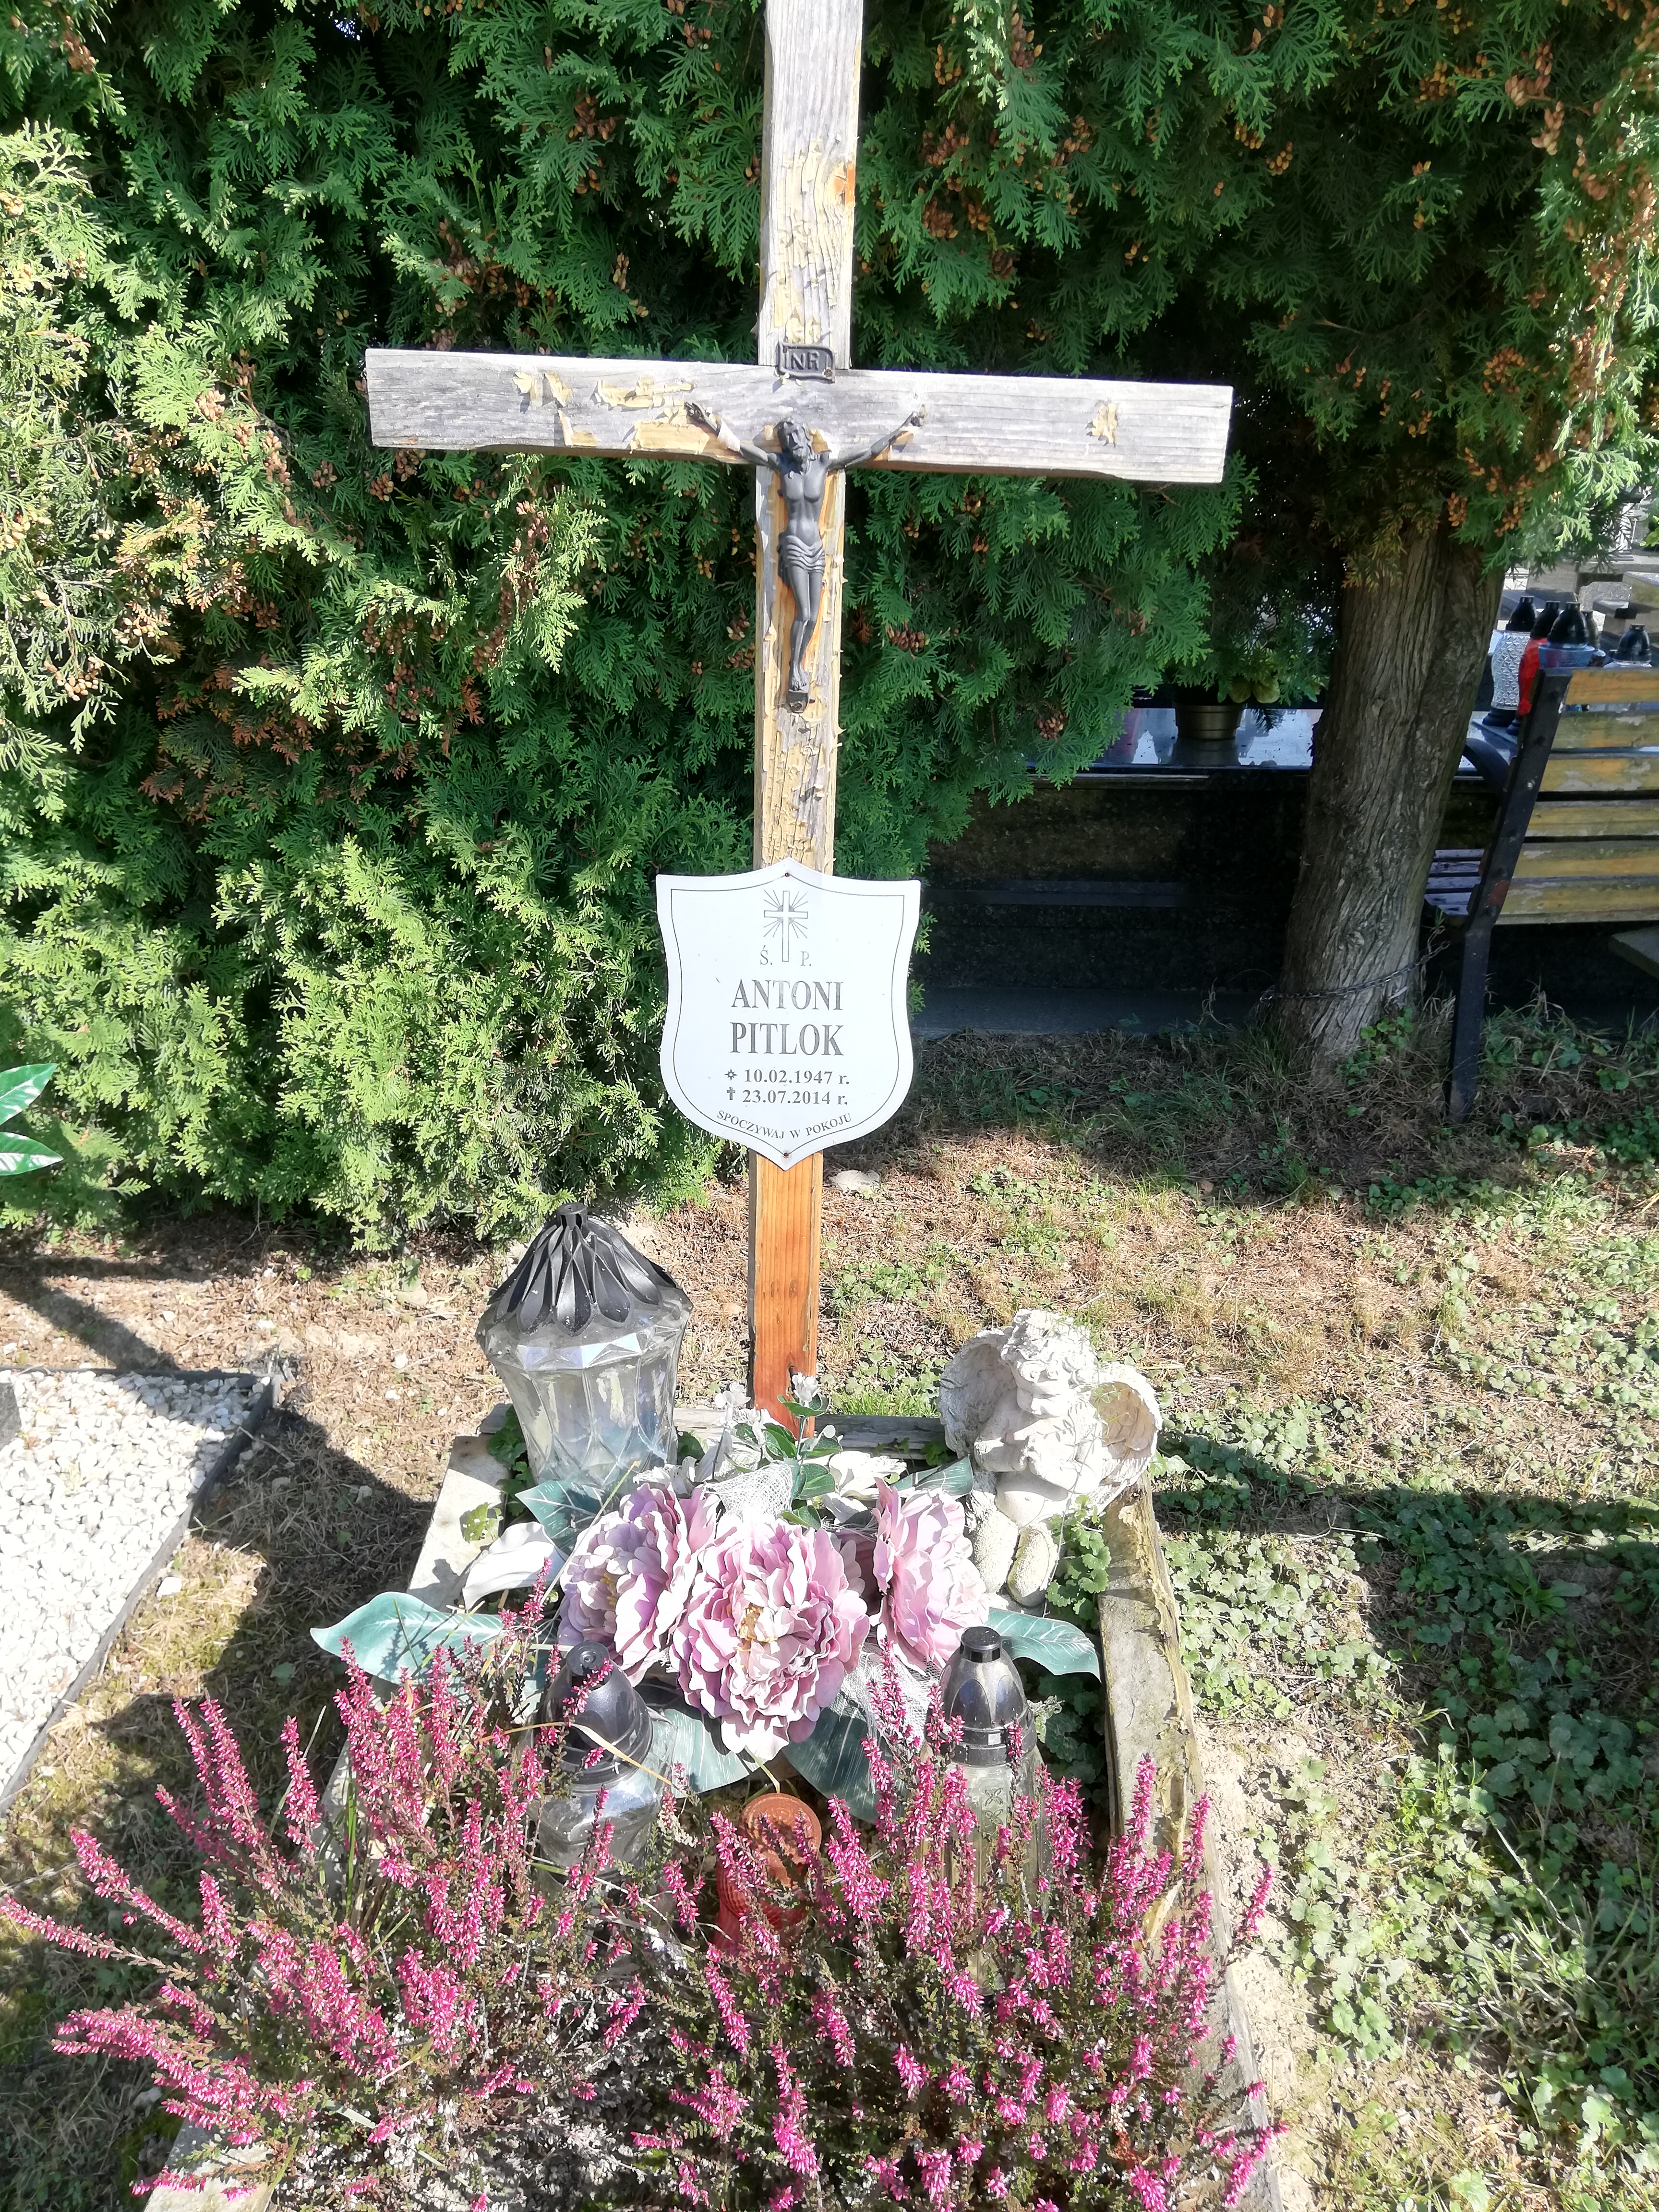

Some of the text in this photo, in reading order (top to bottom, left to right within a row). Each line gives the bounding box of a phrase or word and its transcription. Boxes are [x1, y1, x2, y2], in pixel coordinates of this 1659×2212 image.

[784, 349, 830, 371] INRI
[760, 945, 812, 967] Ś. P.
[731, 979, 843, 1010] ANTONI
[730, 1022, 844, 1056] PITLOK
[745, 1069, 850, 1085] 10.02.1947 r.
[742, 1090, 848, 1105] 23.07.2014 r.
[716, 1110, 853, 1140] SPOCZYWAJ W POKOJU
